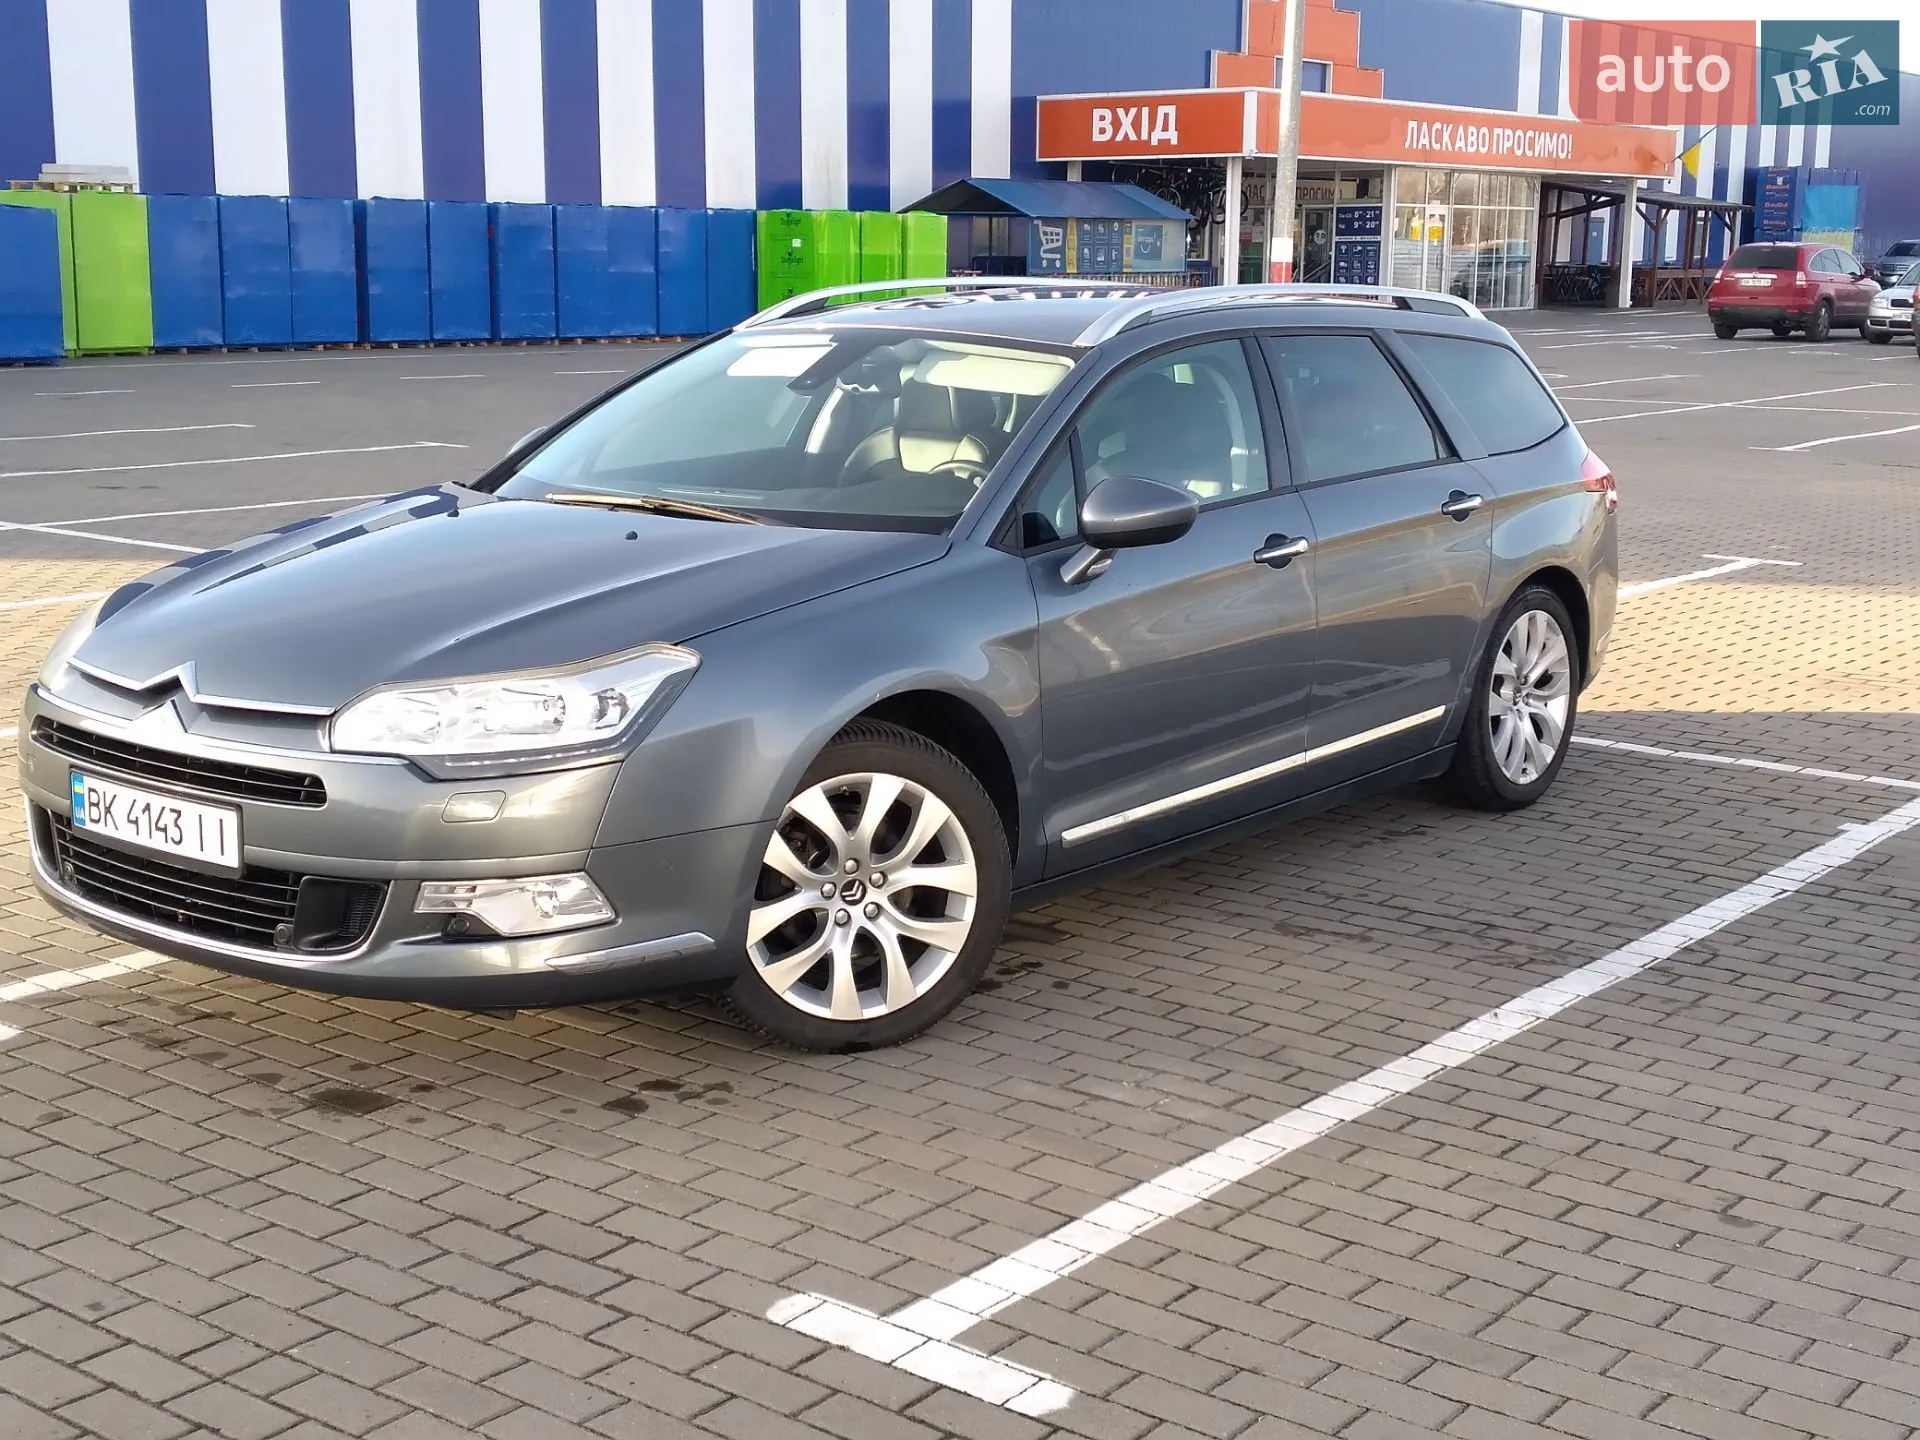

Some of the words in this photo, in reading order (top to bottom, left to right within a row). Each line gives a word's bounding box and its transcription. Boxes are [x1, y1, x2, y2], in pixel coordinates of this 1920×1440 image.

[1091, 104, 1179, 146] ВХІД
[1404, 120, 1489, 154] ЛАСКАВО
[1493, 130, 1574, 159] ПРОСИМО!
[87, 787, 119, 831] BK
[126, 799, 183, 846] 4143
